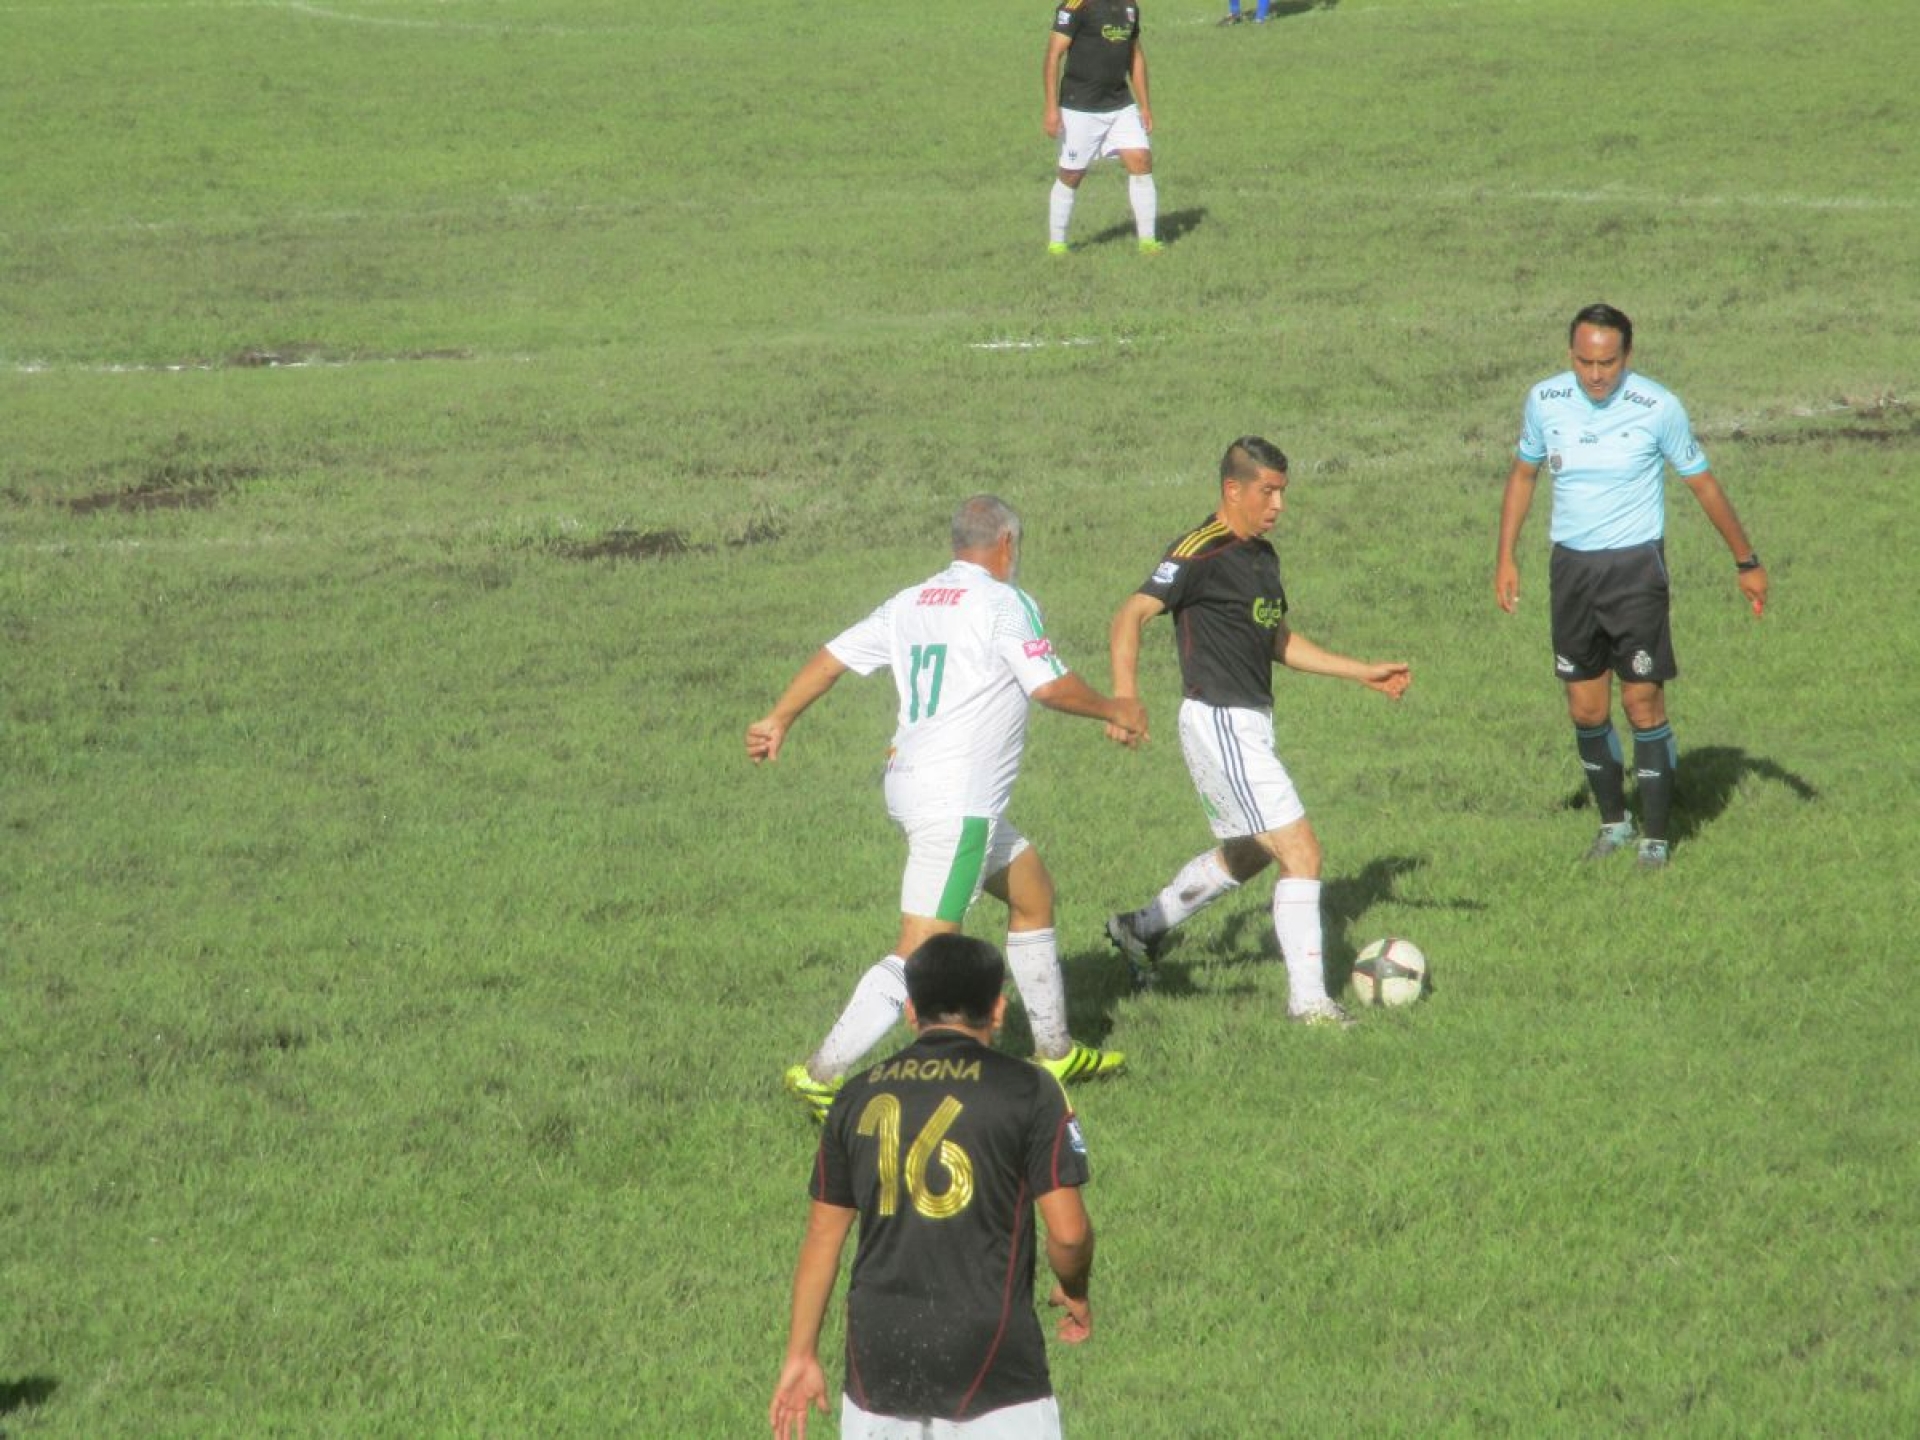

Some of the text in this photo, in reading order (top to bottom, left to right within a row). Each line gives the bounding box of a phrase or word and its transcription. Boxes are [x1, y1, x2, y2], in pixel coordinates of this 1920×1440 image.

[1540, 387, 1573, 400] Voit
[1623, 389, 1657, 408] Voit
[909, 643, 948, 723] 17
[868, 1058, 982, 1083] BARONA
[857, 1093, 973, 1219] 16
